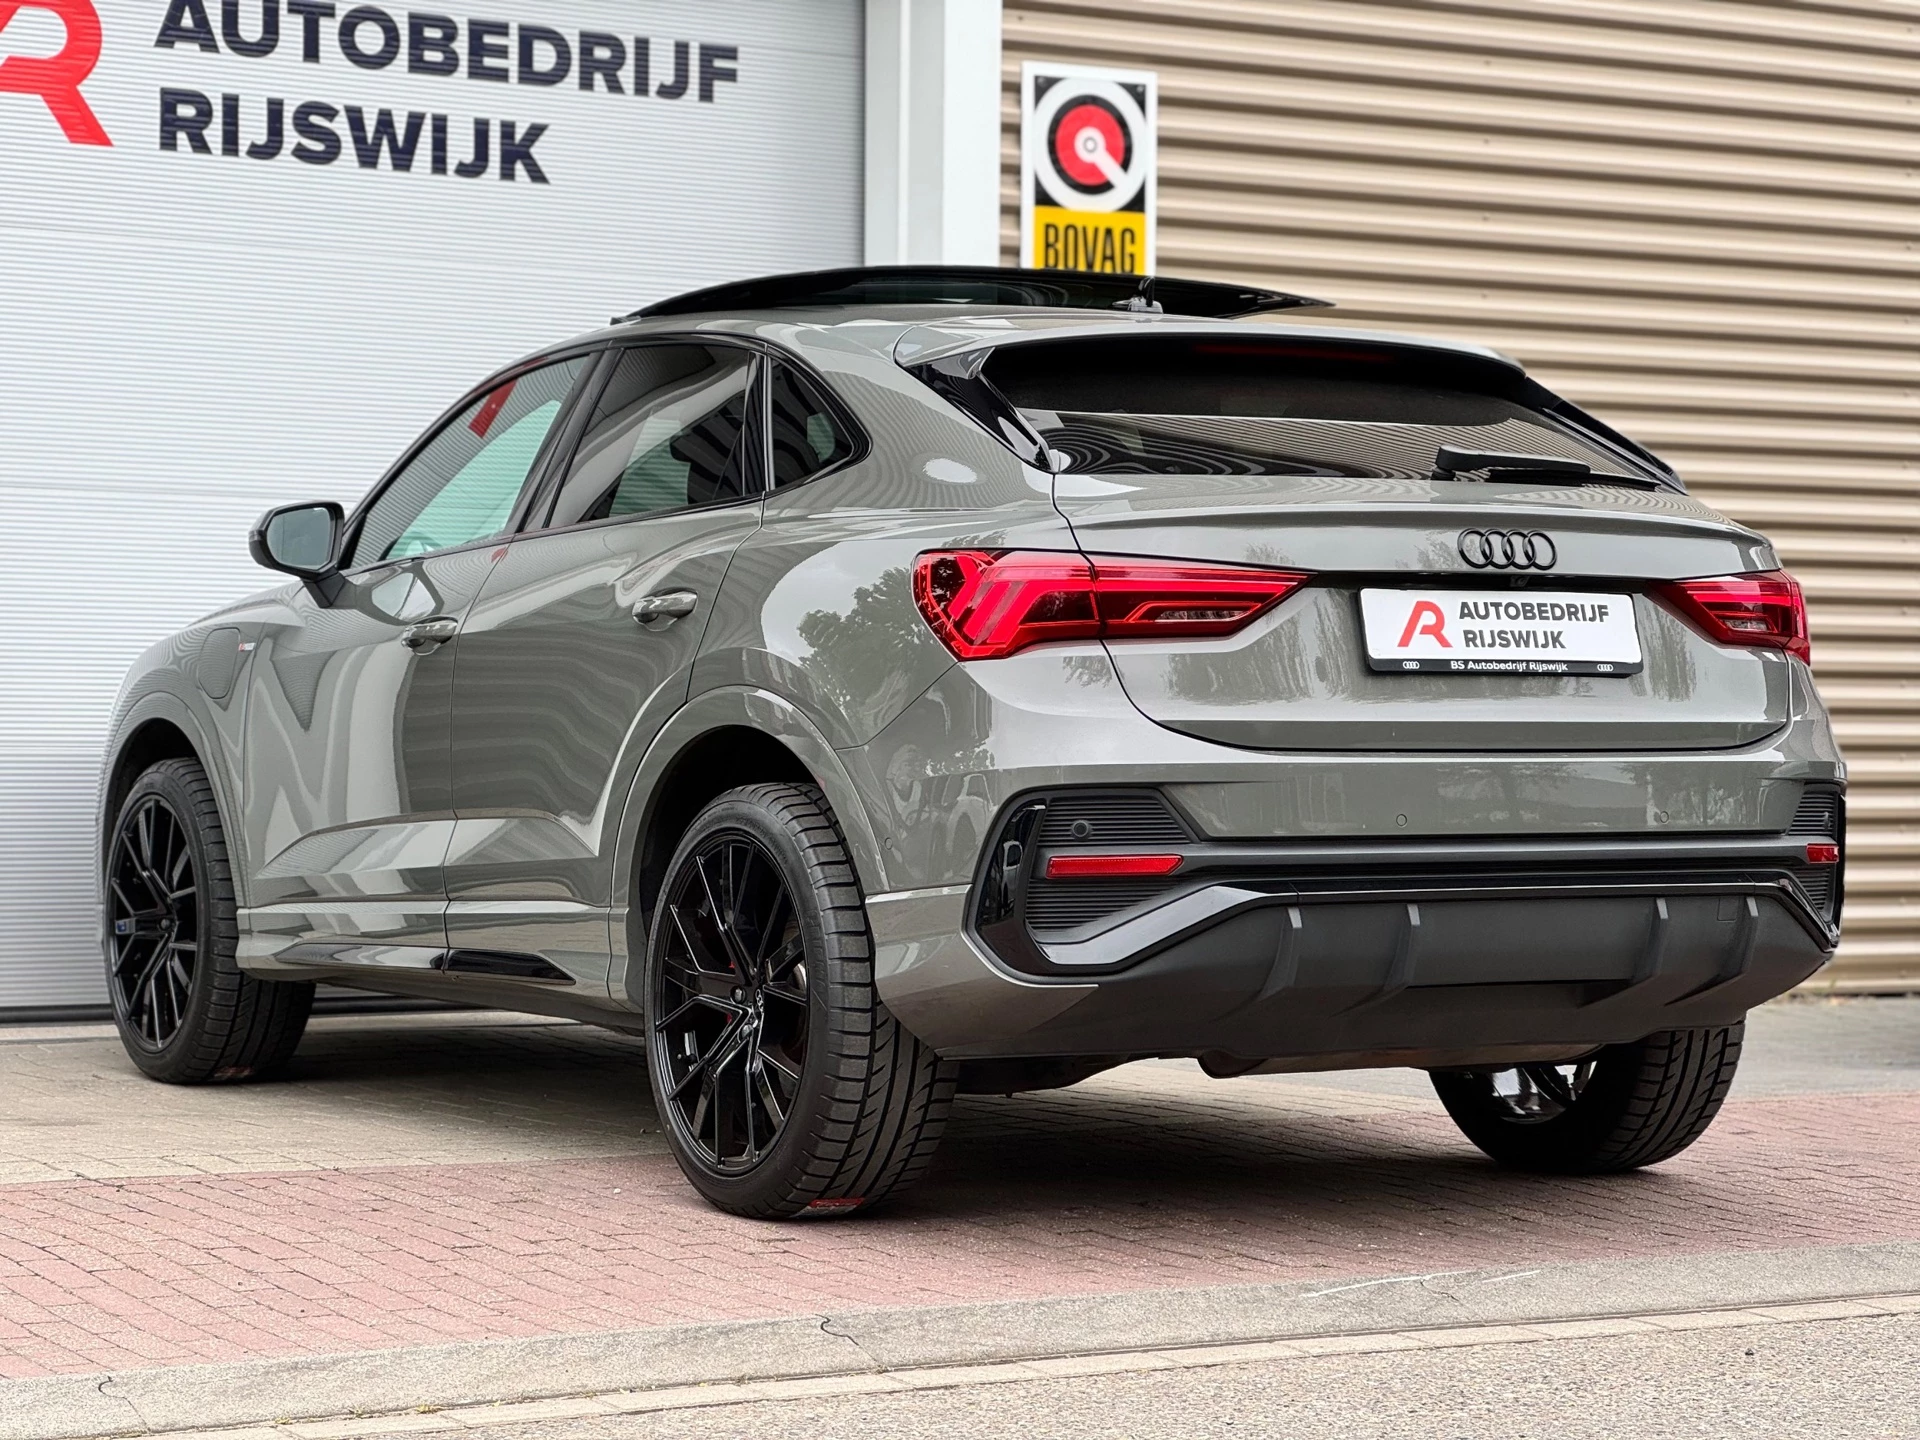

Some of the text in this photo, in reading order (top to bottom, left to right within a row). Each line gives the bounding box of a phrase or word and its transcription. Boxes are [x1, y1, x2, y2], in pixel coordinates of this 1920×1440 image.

[154, 0, 738, 103] AUTOBEDRIJF
[159, 87, 550, 185] RIJSWIJK
[1044, 223, 1136, 274] BOVAG
[1459, 601, 1610, 623] AUTOBEDRIJF
[1462, 629, 1567, 649] RIJSWIJK
[1450, 660, 1569, 673] BS Autobedrijf Rijswijk
